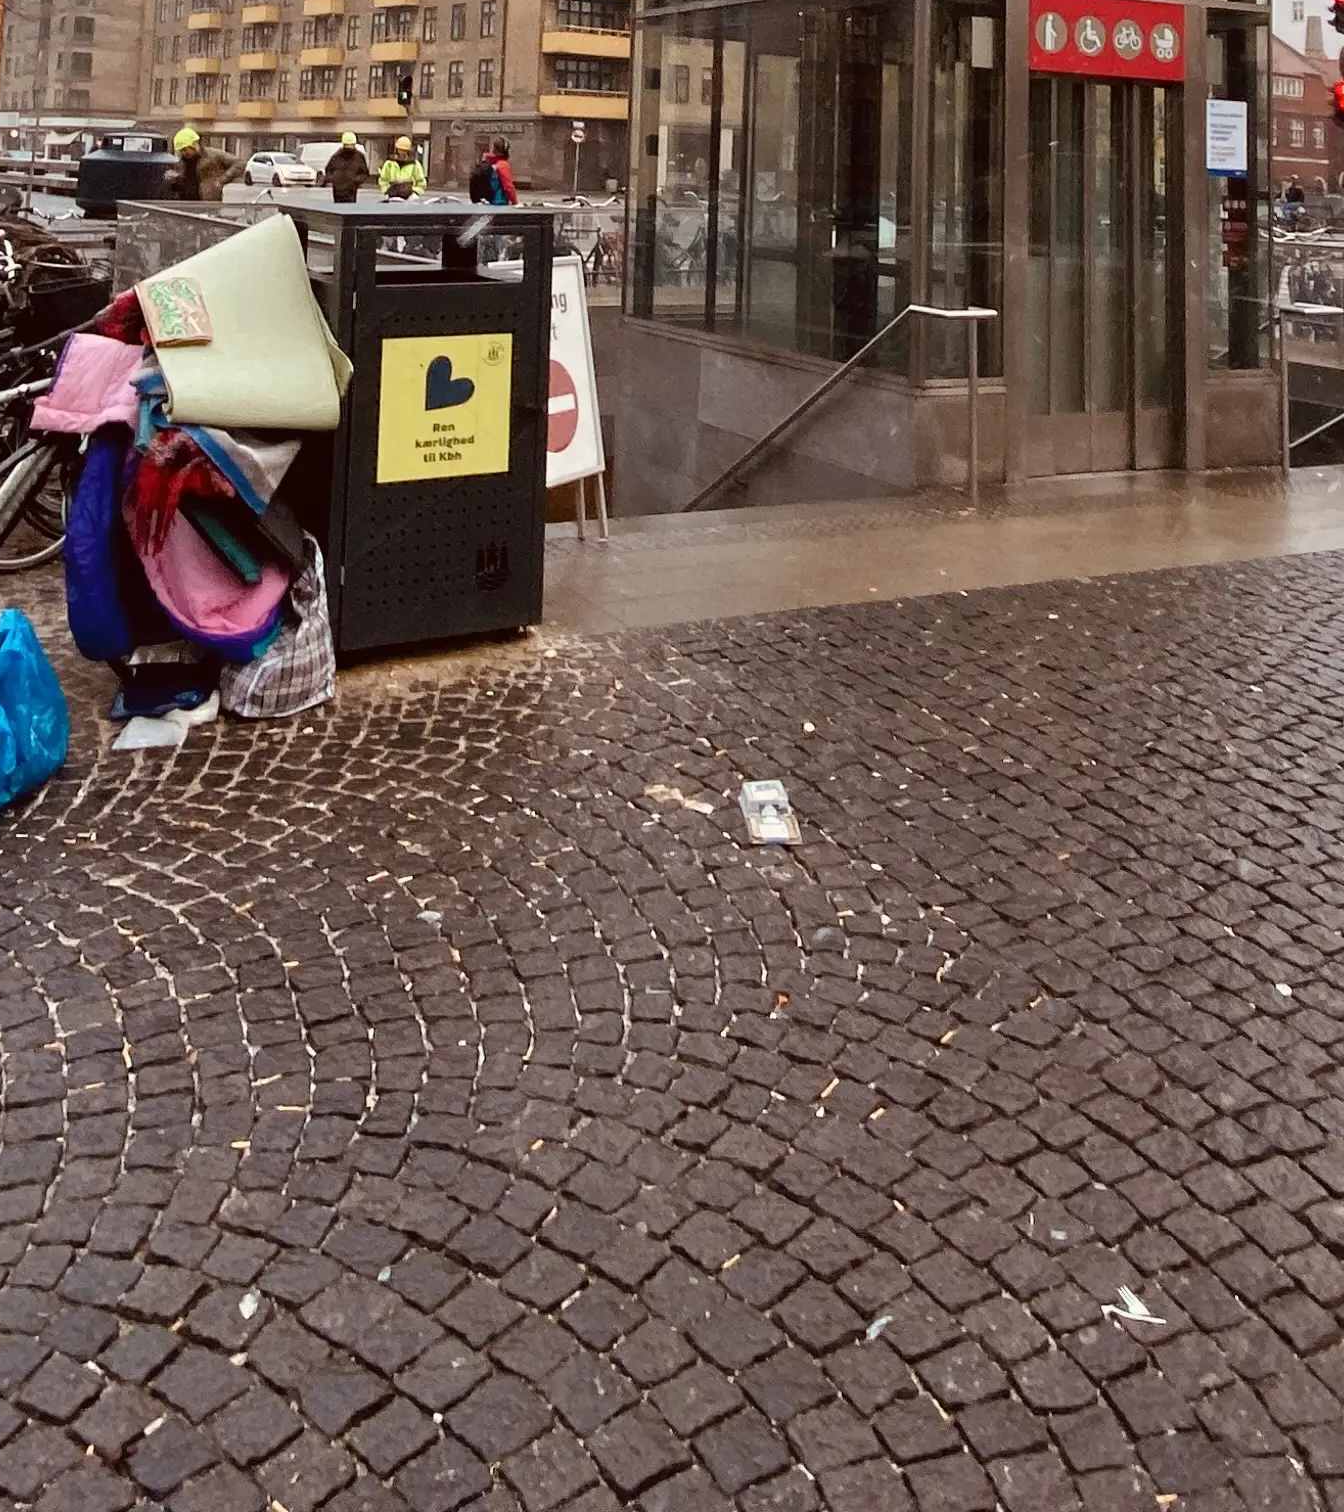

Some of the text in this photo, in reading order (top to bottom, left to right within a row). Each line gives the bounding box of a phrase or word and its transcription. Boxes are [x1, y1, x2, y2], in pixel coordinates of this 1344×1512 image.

[432, 423, 455, 433] Ren
[415, 434, 475, 449] kærlighed
[423, 451, 462, 463] til Kbh
